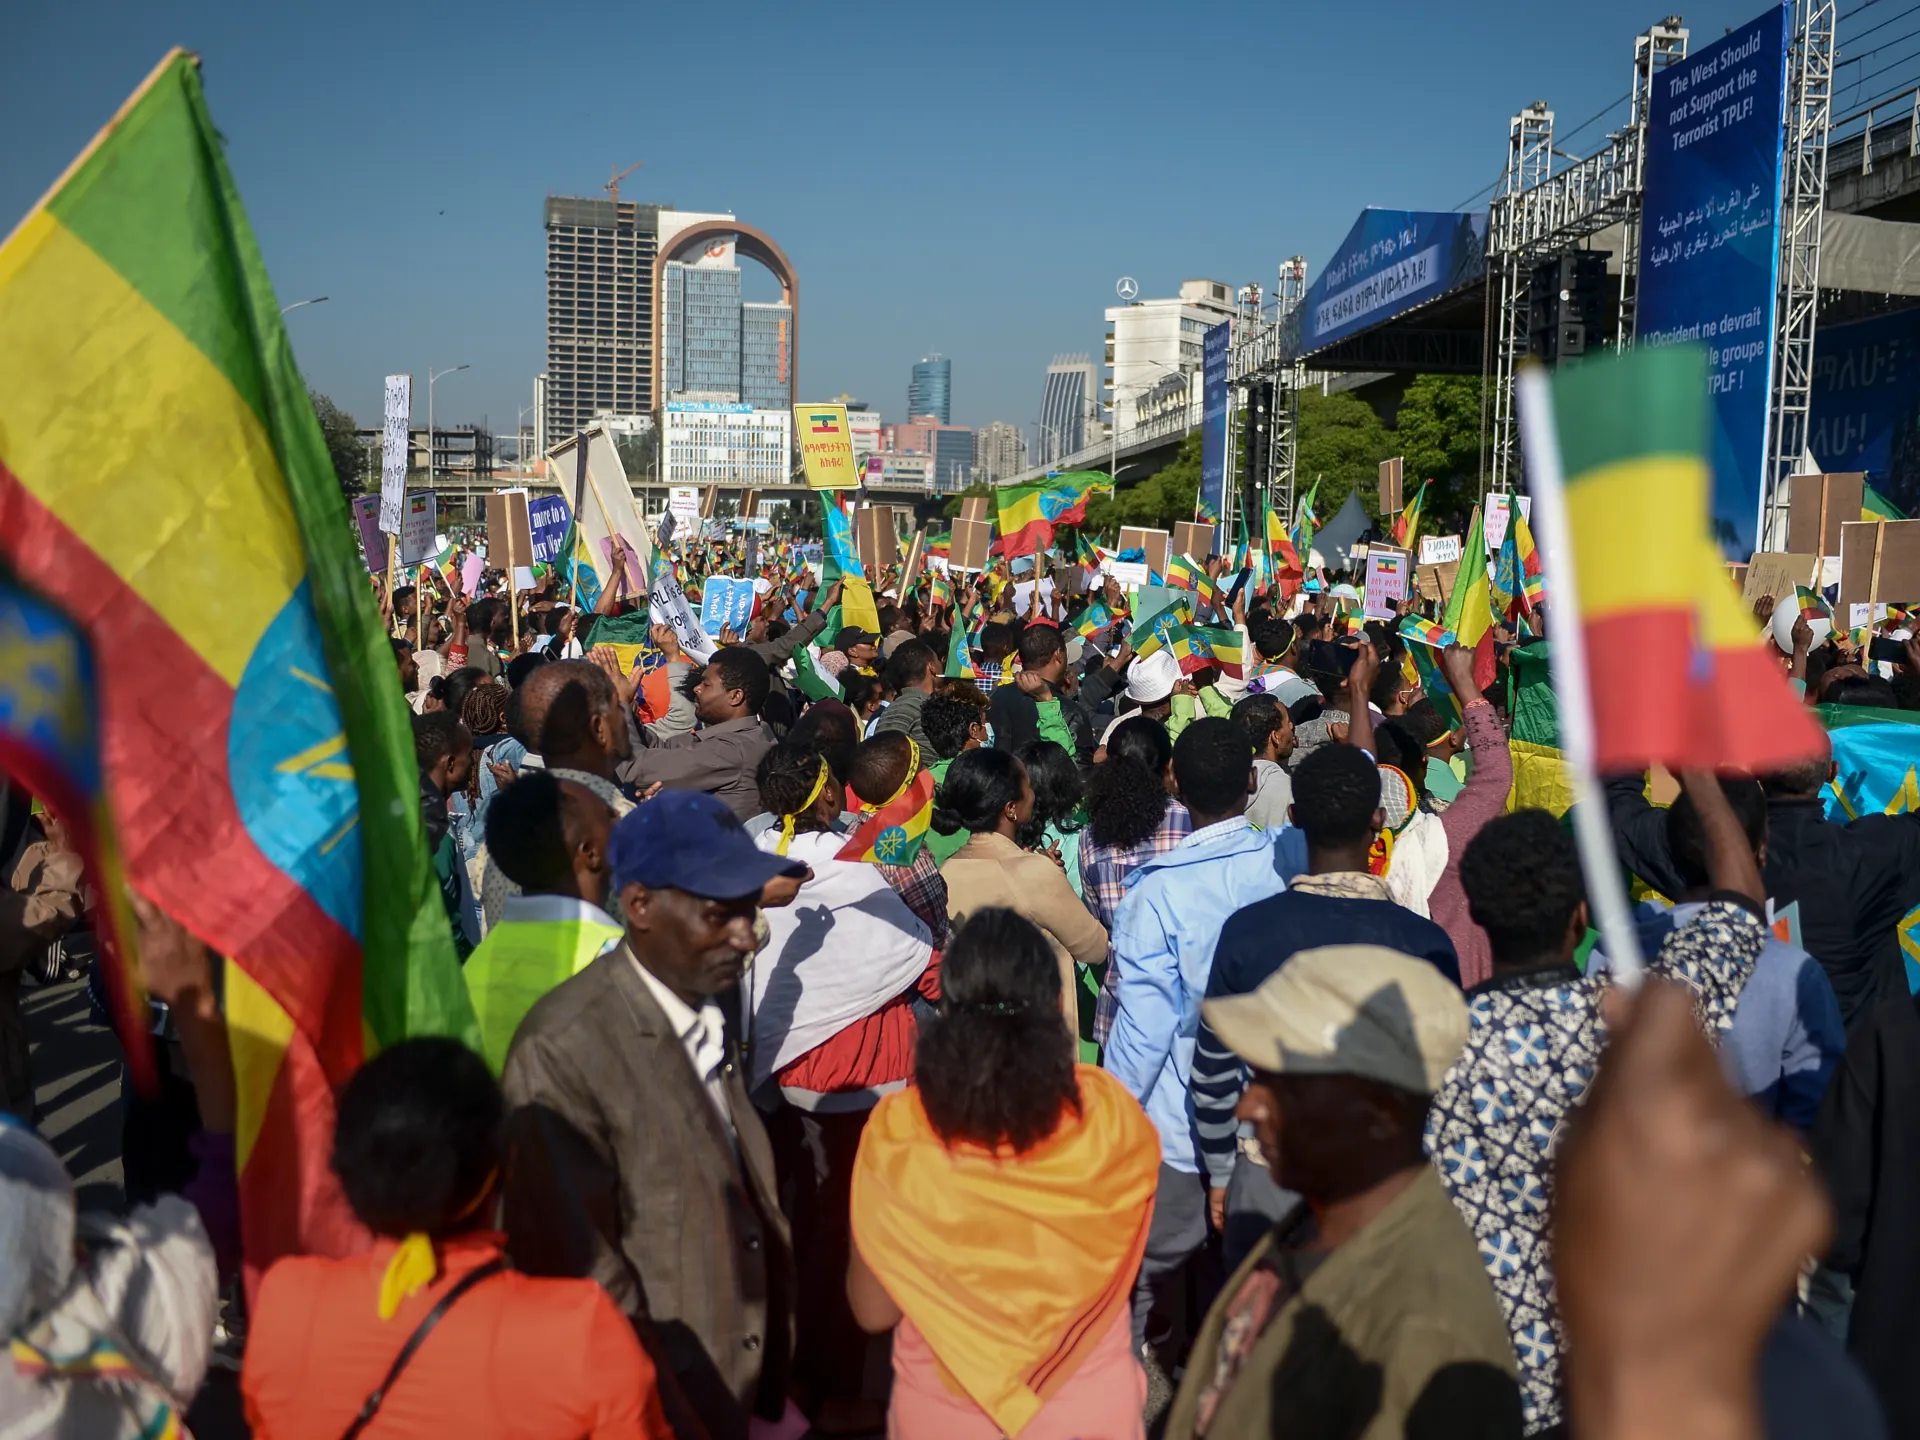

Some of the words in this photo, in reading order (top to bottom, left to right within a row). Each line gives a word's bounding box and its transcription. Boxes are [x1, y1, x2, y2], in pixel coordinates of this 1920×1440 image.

[1669, 76, 1688, 98] The
[1690, 61, 1718, 87] West
[1720, 30, 1761, 71] Should
[1669, 106, 1688, 126] not
[1690, 80, 1735, 116] Support
[1737, 68, 1757, 92] the
[1672, 118, 1719, 151] Terrorist
[1721, 97, 1753, 128] TPLF!
[1717, 189, 1740, 215] الغرب
[1742, 182, 1760, 210] على
[1658, 212, 1683, 238] الجبهة
[1684, 207, 1703, 232] يدعم
[1740, 208, 1772, 238] الشعبية
[1710, 220, 1737, 249] لتحرير
[1702, 322, 1717, 339] ne
[1719, 306, 1761, 333] devrait
[1709, 347, 1719, 367] le
[1721, 340, 1765, 369] groupe
[1707, 371, 1737, 395] TPLF
[532, 509, 551, 528] more
[551, 504, 560, 523] to
[560, 506, 566, 521] a
